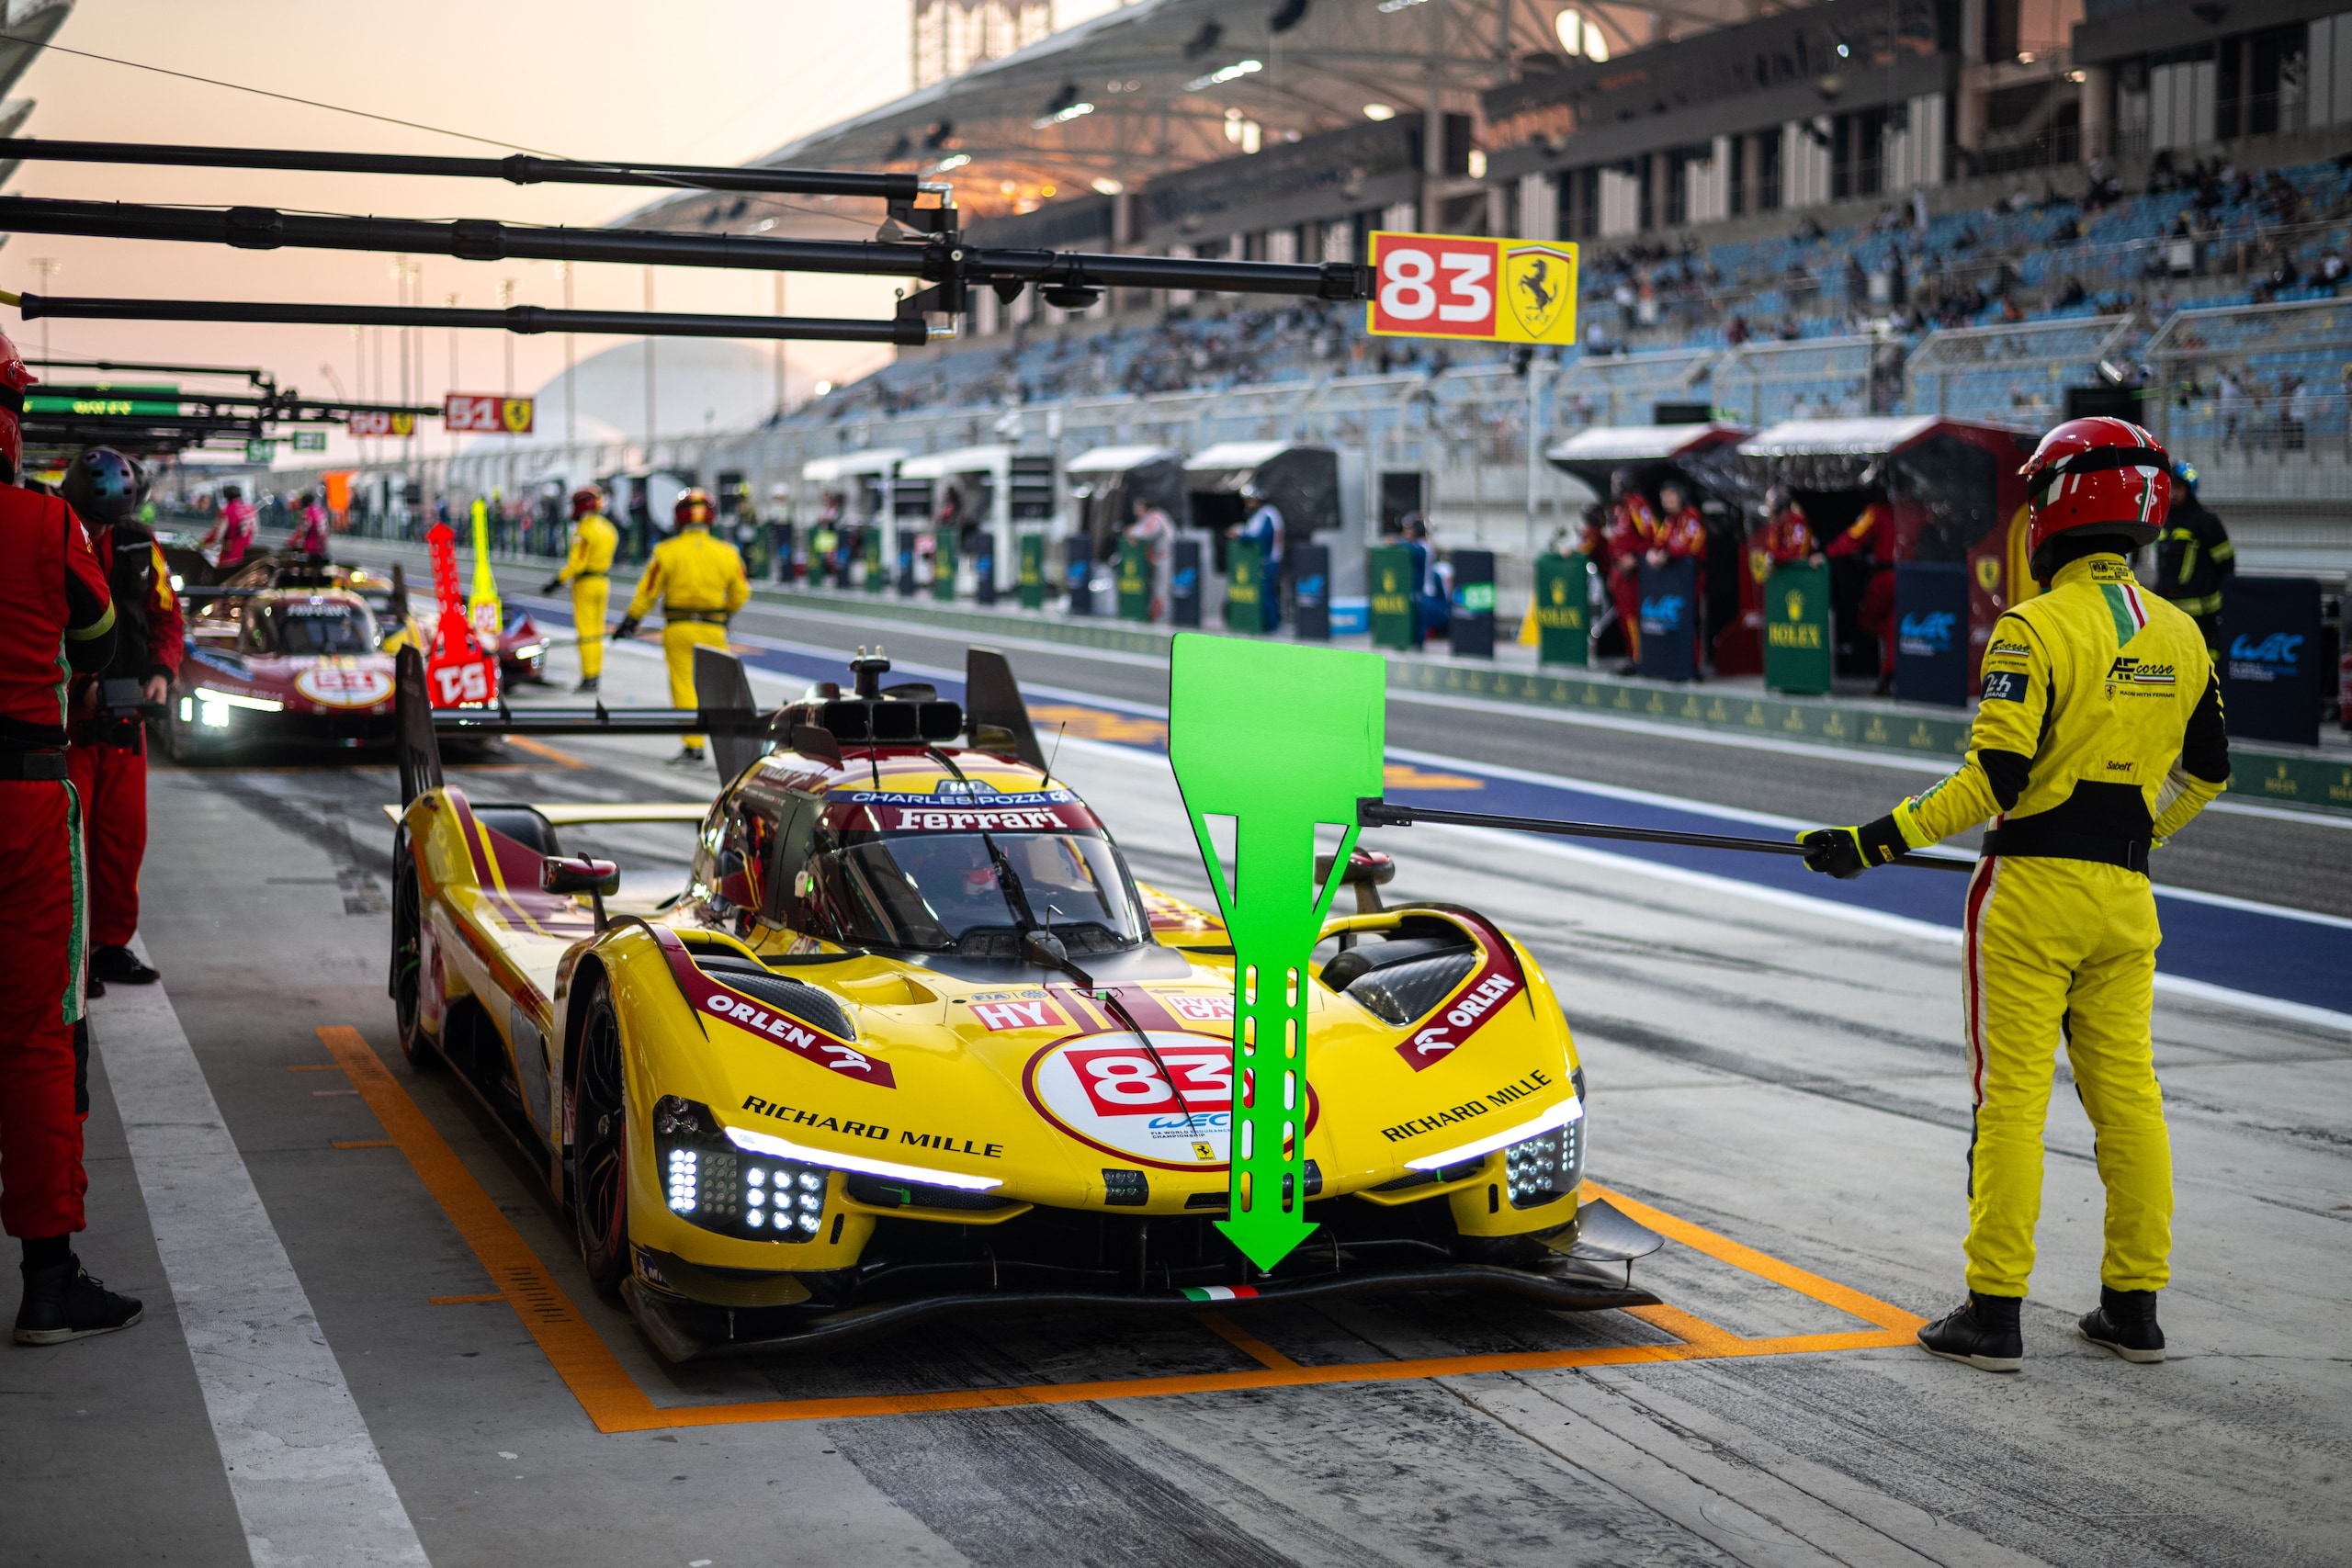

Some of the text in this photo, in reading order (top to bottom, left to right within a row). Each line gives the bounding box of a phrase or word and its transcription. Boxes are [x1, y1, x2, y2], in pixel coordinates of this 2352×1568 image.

[1380, 249, 1491, 322] 83
[447, 397, 499, 429] 51
[1768, 622, 1821, 649] ROLEX
[2107, 657, 2175, 680] AF corse
[852, 792, 1047, 806] CHARLES POZZI
[896, 807, 1068, 829] Ferrari
[1172, 998, 1234, 1007] HYPE
[1182, 1005, 1235, 1019] CA
[1447, 973, 1515, 1028] ORLEN
[707, 995, 816, 1049] ORLEN
[974, 1001, 1048, 1029] HY
[1085, 1055, 1233, 1105] 83
[1381, 1069, 1553, 1143] RICHARD MILLE
[741, 1095, 1004, 1158] RICHARD MILLE
[1148, 1113, 1230, 1129] WEC
